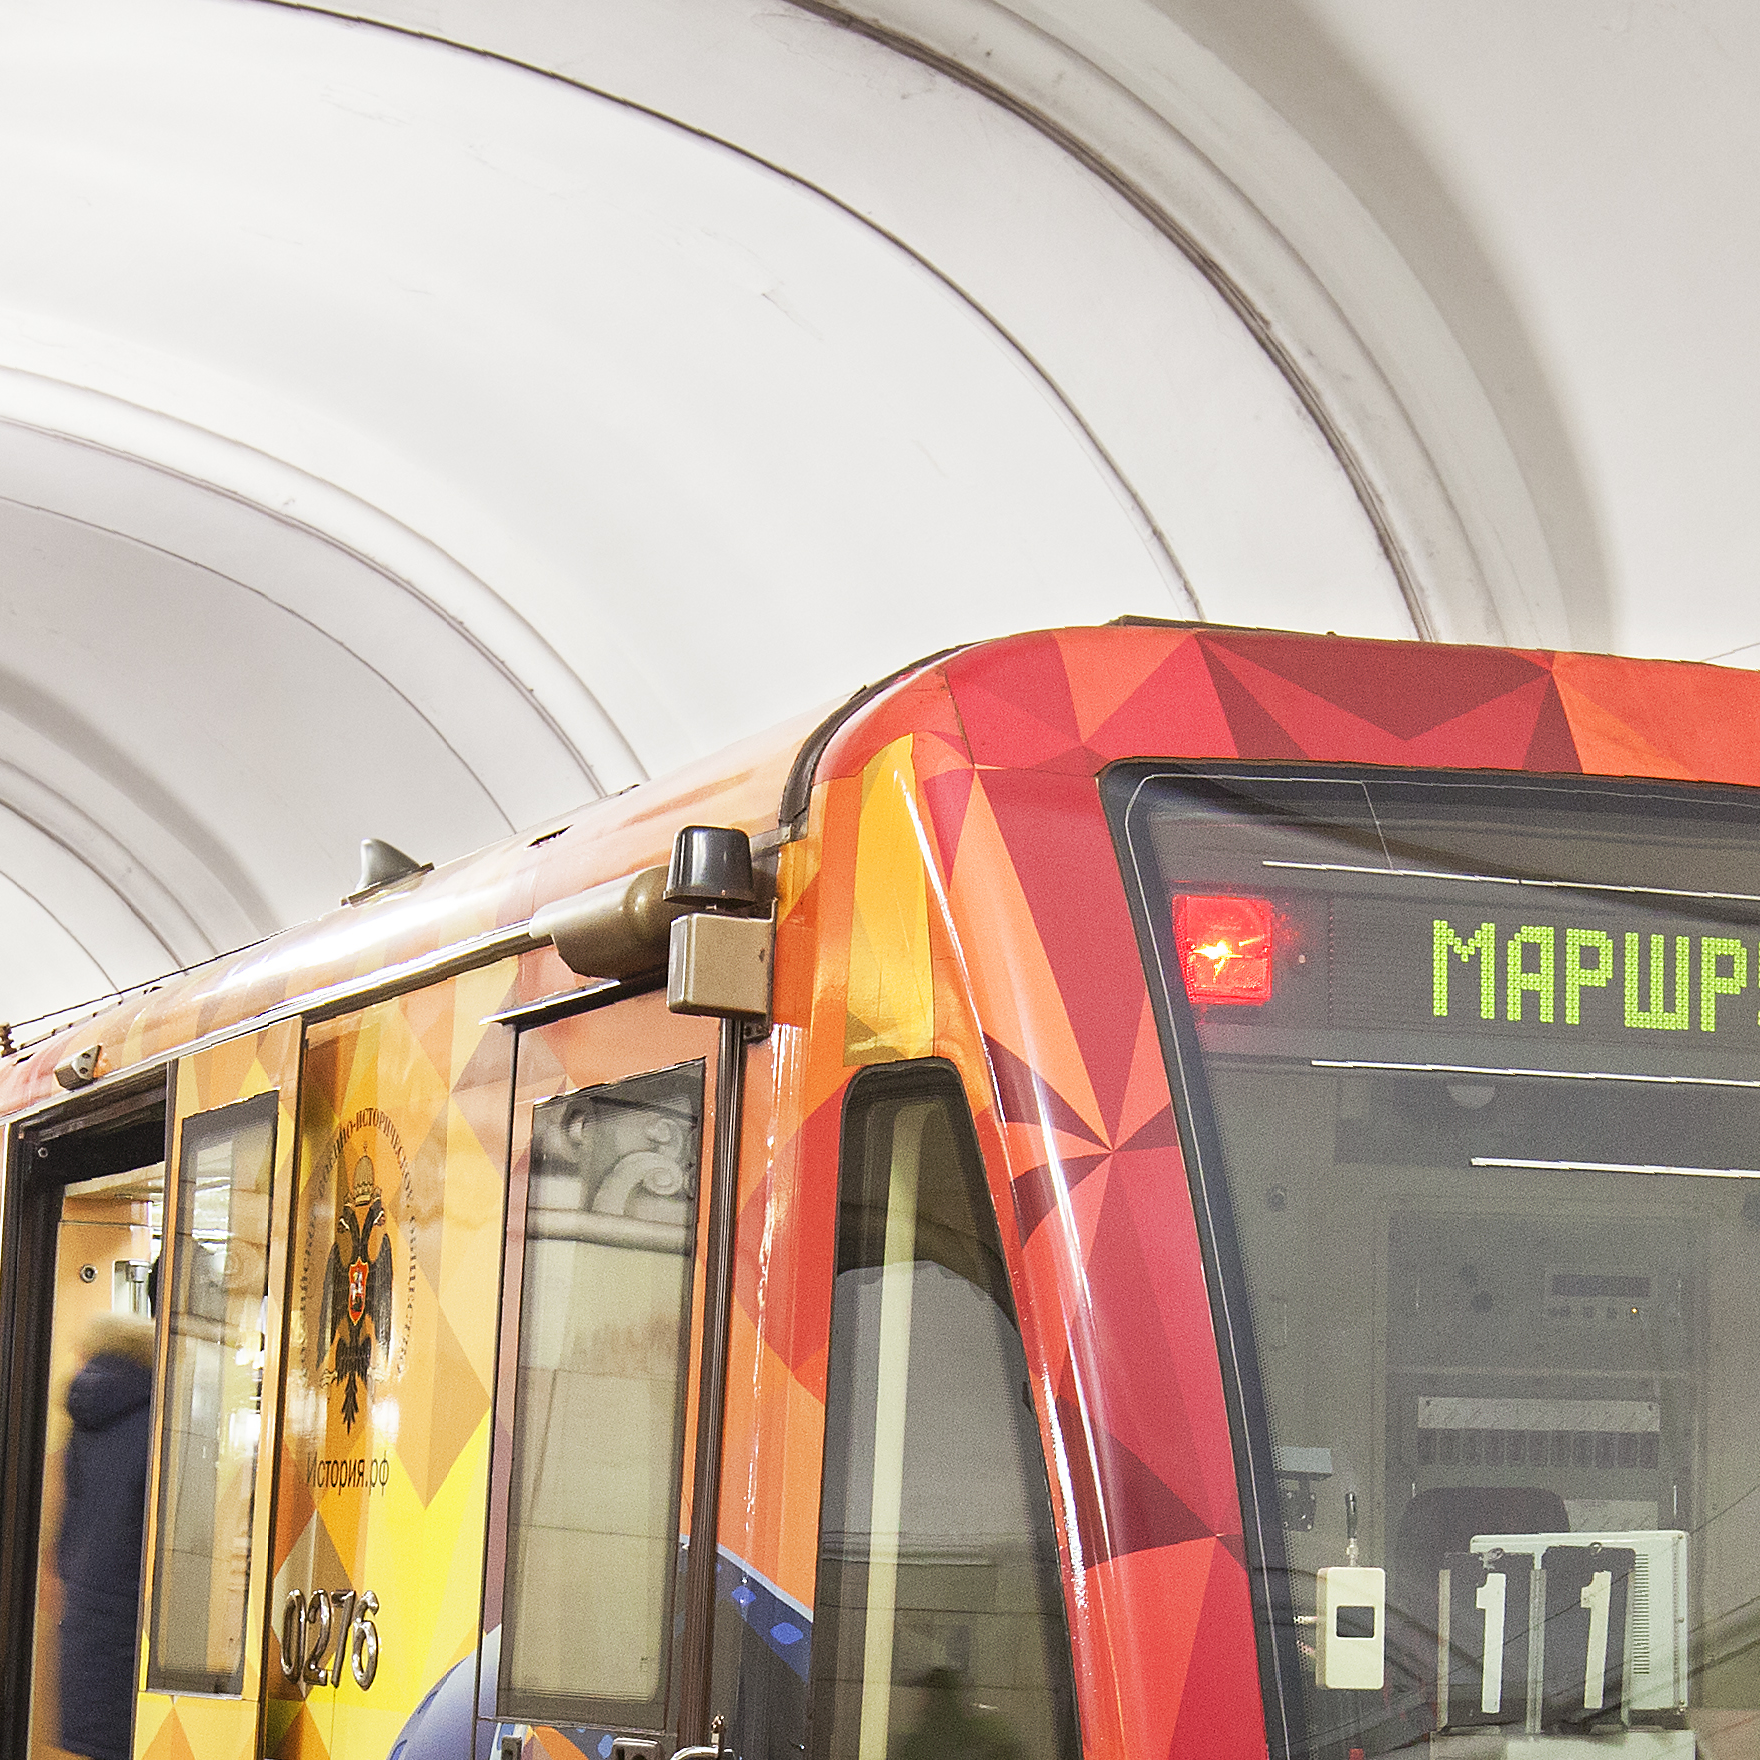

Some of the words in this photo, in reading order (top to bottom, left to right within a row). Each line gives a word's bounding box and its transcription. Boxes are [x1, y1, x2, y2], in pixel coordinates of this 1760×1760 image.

[306, 1449, 390, 1497] История.рф
[281, 1589, 380, 1692] 0276
[1475, 1569, 1612, 1715] 11
